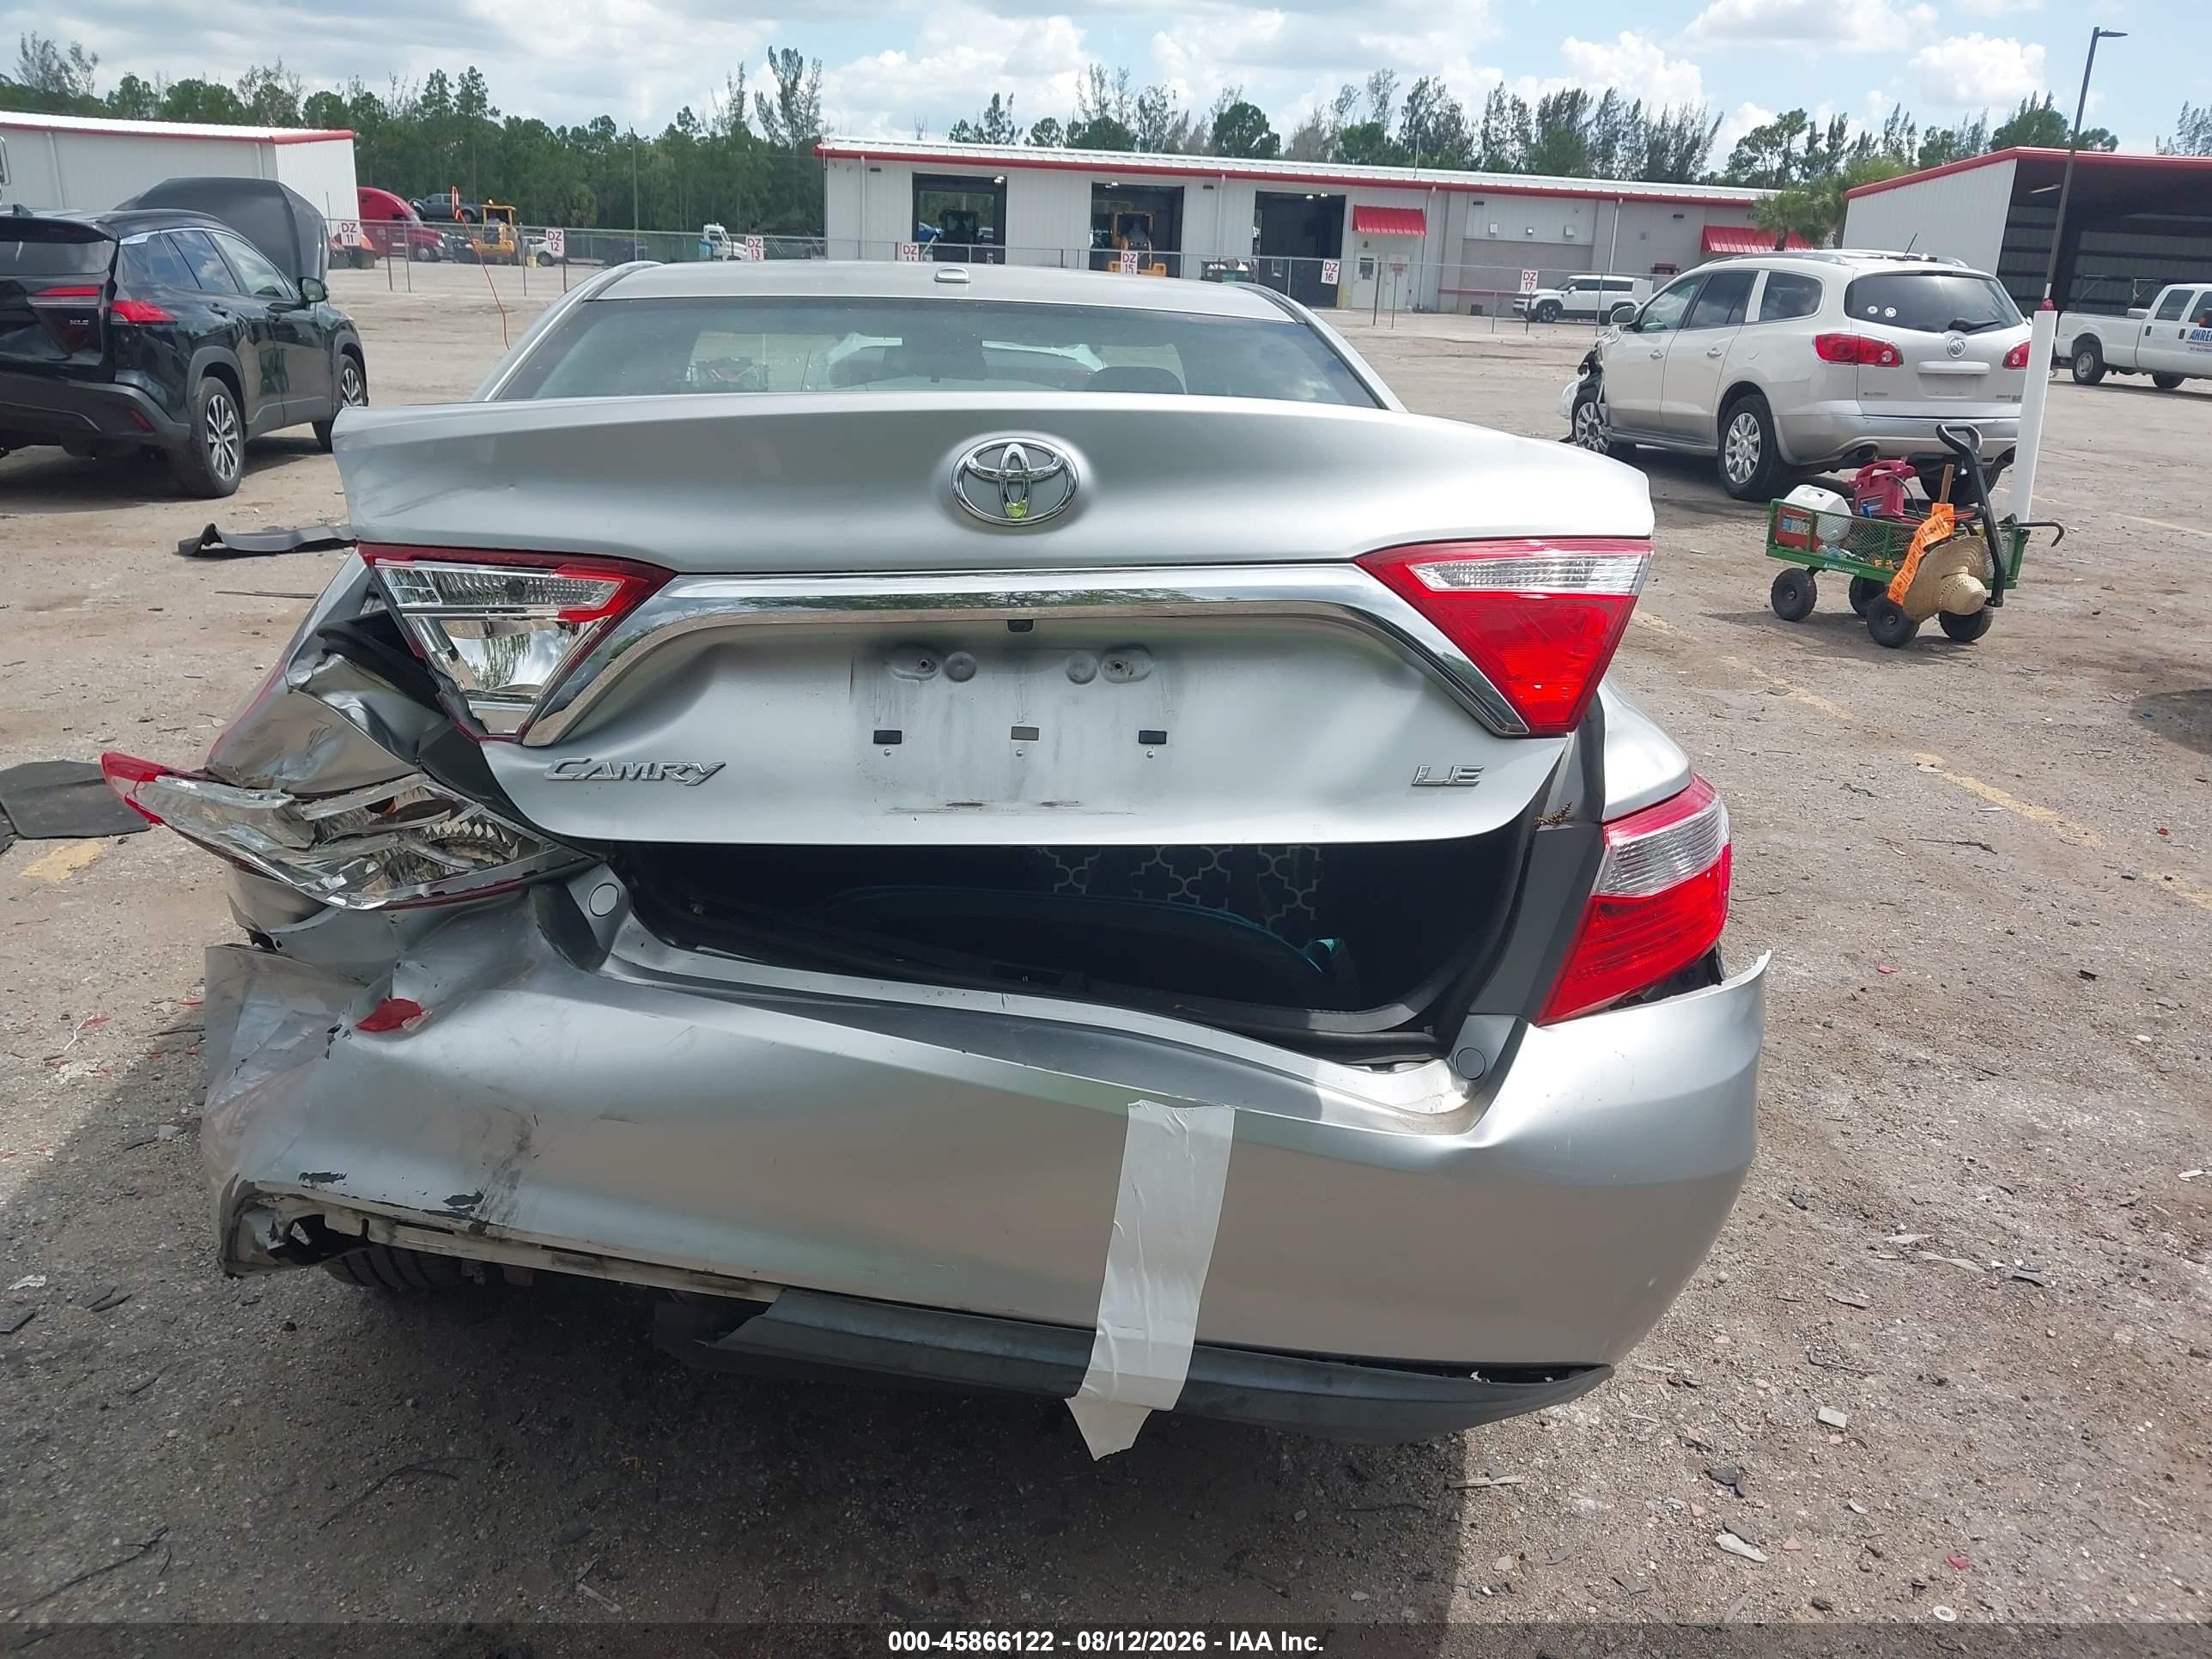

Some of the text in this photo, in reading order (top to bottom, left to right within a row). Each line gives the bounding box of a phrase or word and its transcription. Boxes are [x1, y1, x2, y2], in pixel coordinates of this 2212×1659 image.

[341, 222, 357, 233] DZ
[346, 233, 354, 244] 11
[547, 230, 562, 241] DZ
[550, 241, 560, 252] 12
[747, 238, 762, 248] DZ
[750, 248, 760, 261] 13
[902, 245, 917, 255] DZ
[1122, 252, 1136, 263] DZ
[1125, 264, 1134, 275] 15
[1324, 261, 1338, 272] DZ
[1325, 271, 1334, 282] 16
[1522, 271, 1536, 282] DZ
[1524, 282, 1533, 291] 17
[544, 757, 726, 786] CAMRY
[1411, 764, 1485, 787] LE
